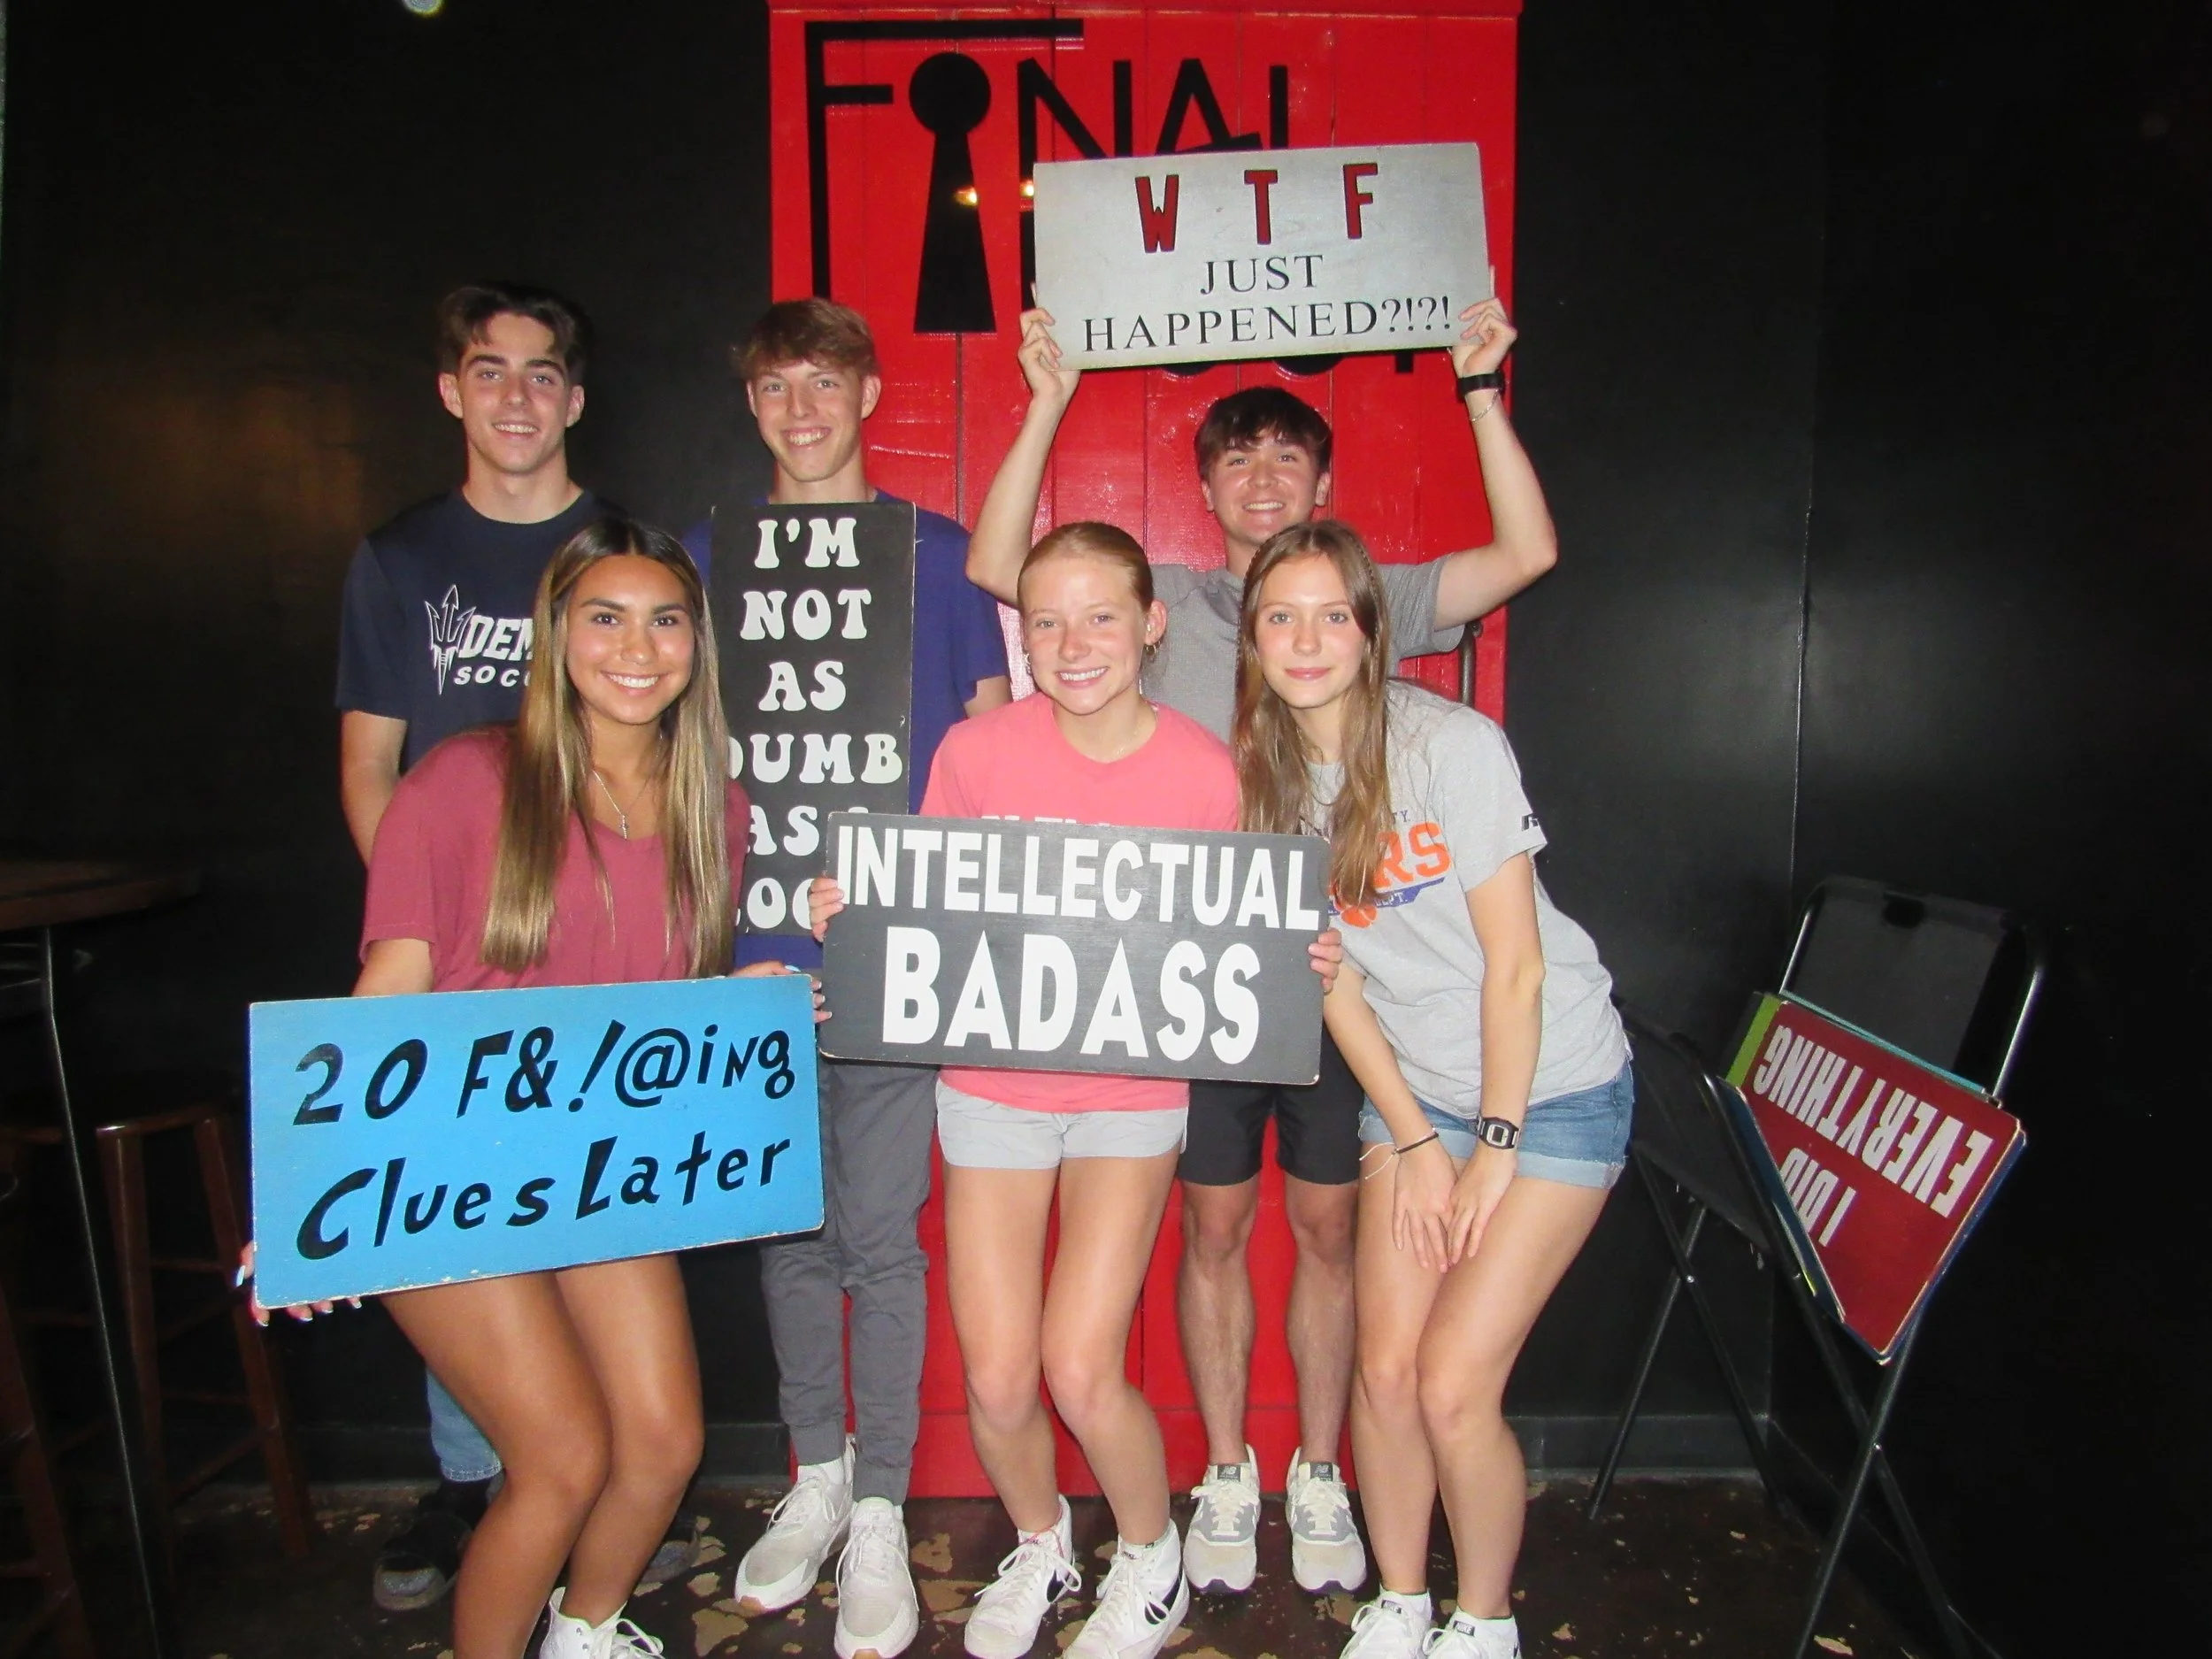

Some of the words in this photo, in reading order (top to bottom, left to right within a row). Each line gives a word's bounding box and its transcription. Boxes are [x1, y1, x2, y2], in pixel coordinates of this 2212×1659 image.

[1200, 254, 1323, 295] JUST
[1082, 296, 1452, 352] HAPPENED?!?!
[755, 518, 860, 569] I'M
[740, 589, 872, 641] NOT
[453, 665, 531, 687] SOC
[758, 661, 847, 711] AS
[838, 826, 1320, 932] INTELLECTUAL
[882, 926, 1261, 1064] BADASS
[293, 1039, 427, 1125] 20
[1753, 1025, 1993, 1218] EVERYTHING
[296, 1157, 556, 1260] Clues
[576, 1131, 790, 1220] Later
[1818, 1186, 1856, 1248] I
